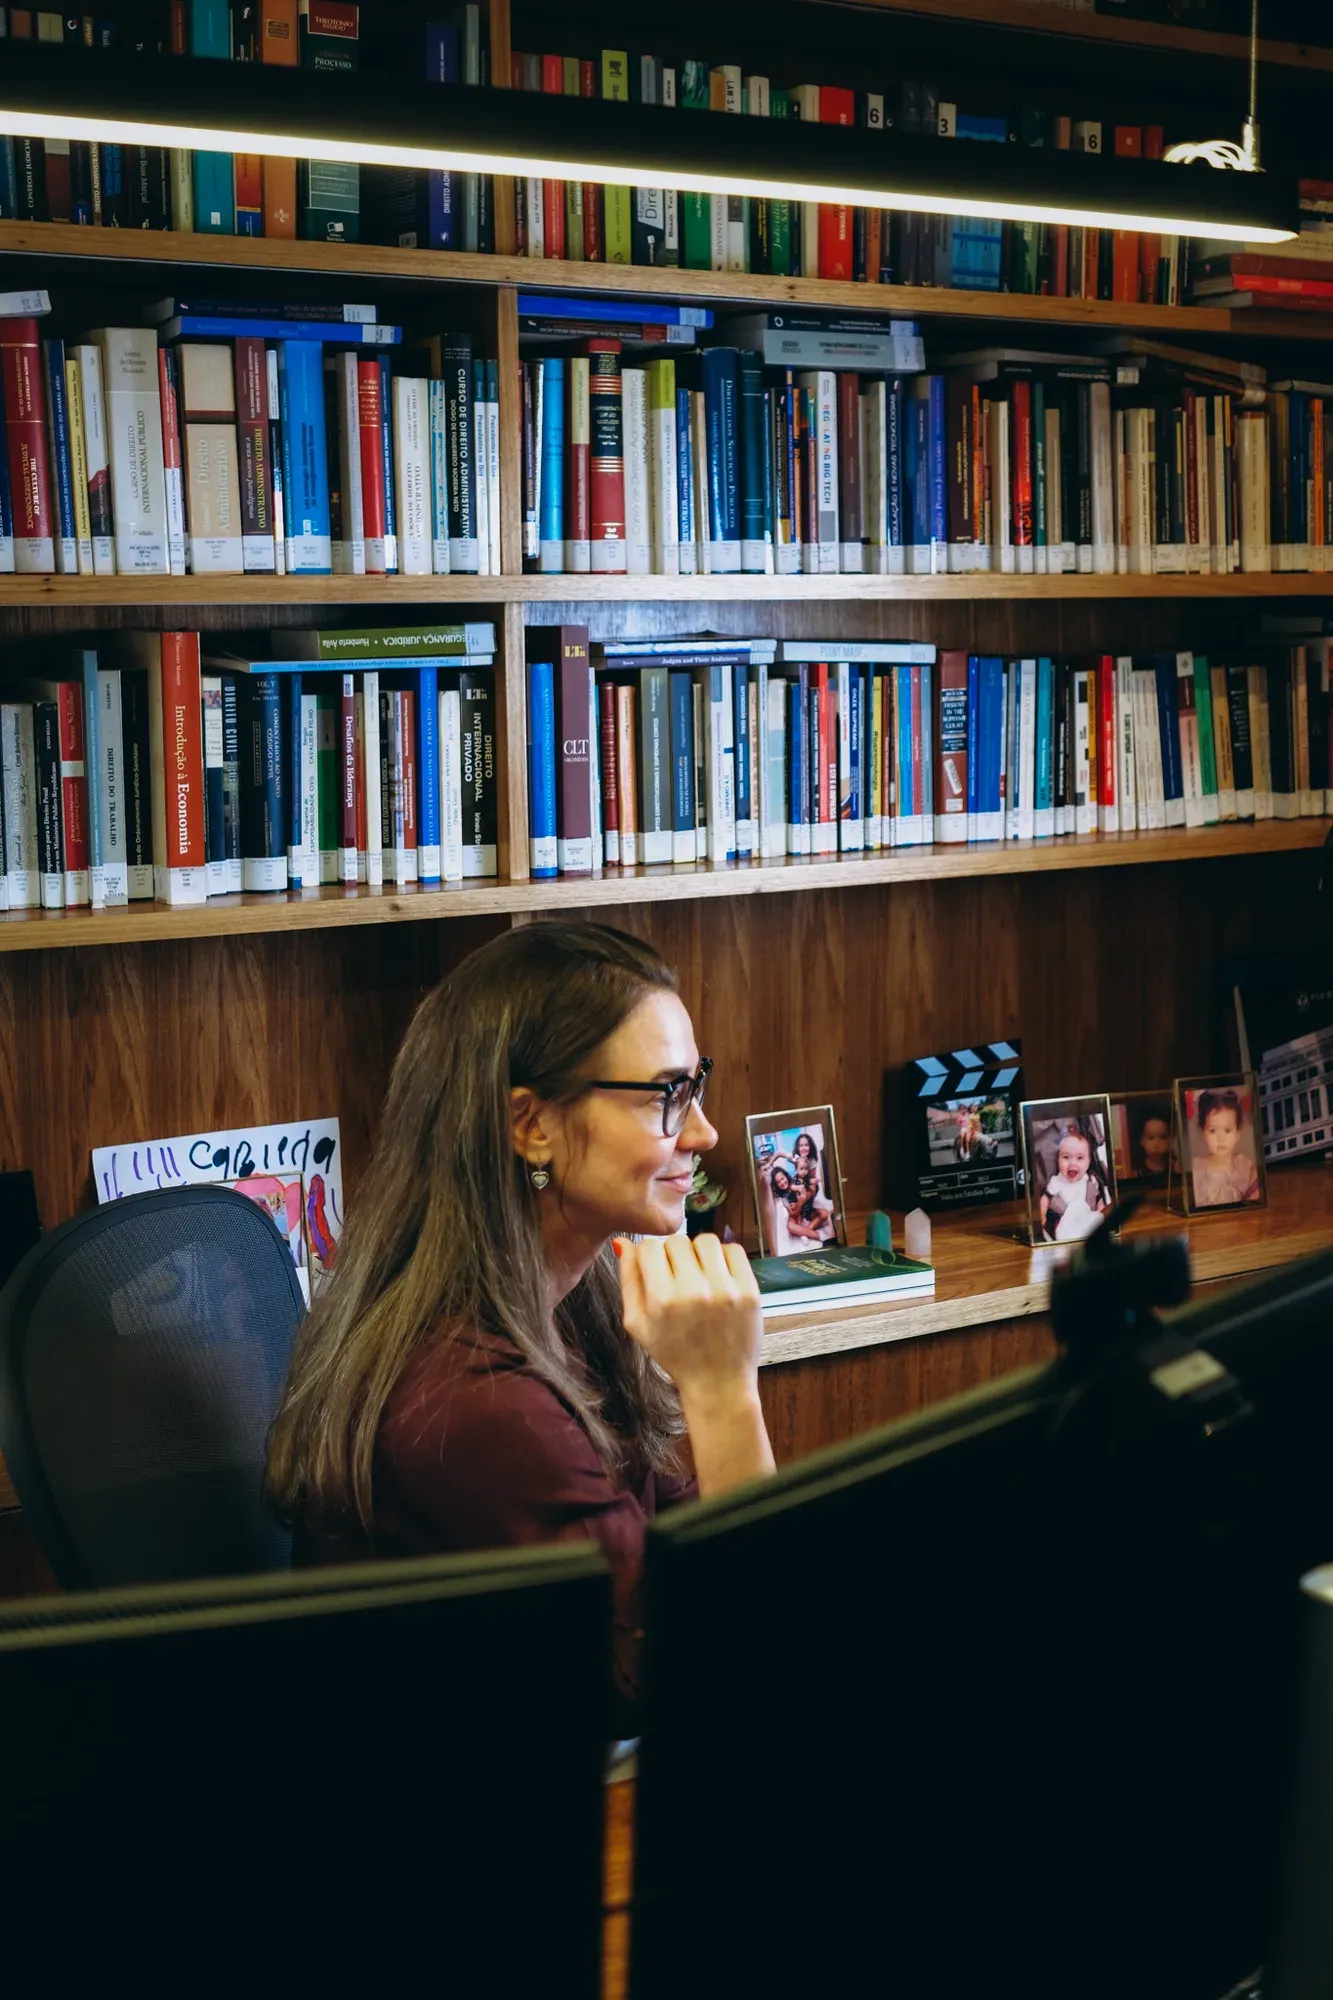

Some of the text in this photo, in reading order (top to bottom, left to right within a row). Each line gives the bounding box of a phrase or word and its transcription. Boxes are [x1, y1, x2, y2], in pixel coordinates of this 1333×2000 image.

[314, 16, 354, 28] THEOTONIO
[314, 57, 352, 69] PROCESSO
[869, 108, 880, 124] 6
[939, 118, 949, 134] 3
[1088, 134, 1098, 150] 6
[140, 178, 149, 203] Marçal
[442, 188, 451, 214] DIREITO
[645, 189, 658, 219] Dire
[627, 375, 638, 448] Administrativo
[725, 379, 733, 417] DIREITO
[451, 422, 457, 430] DE
[60, 445, 69, 486] CONTROVÉRSIAS
[127, 425, 138, 499] CURSO DE DIREITO
[136, 410, 151, 513] INTERNACIONAL PÚBLICO
[195, 439, 210, 484] Direito
[245, 442, 253, 457] seus
[457, 368, 470, 539] CURSO DE DIREITO ADMINISTRATIVO
[726, 439, 735, 482] SERVIÇOS
[20, 442, 34, 529] JUDICIAL INDEPENDENCE
[216, 439, 230, 532] Administrativo
[254, 428, 266, 528] DIREITO ADMINISTRATIVO
[823, 463, 831, 478] BIG
[890, 454, 898, 484] NOVAS
[31, 473, 39, 503] CULTURE
[245, 478, 255, 519] paradigmas
[407, 500, 413, 511] DE
[33, 504, 40, 515] OF
[891, 494, 899, 544] REGULAÇÃO
[322, 634, 466, 650] EGURANÇA JURÍDICA Humberto Ávila
[820, 644, 843, 657] POINT
[661, 657, 682, 665] Judges
[695, 656, 710, 664] Their
[66, 691, 77, 750] Simone Schreiber
[174, 705, 187, 770] Introdução
[224, 686, 237, 754] DIREITO CIVIL
[266, 728, 274, 759] CÓDIGO
[464, 732, 472, 782] PRIVADO
[473, 712, 482, 802] INTERNACIONAL
[484, 734, 492, 778] DIREITO
[563, 739, 590, 755] CLT
[50, 762, 58, 797] Republicano
[275, 763, 281, 774] AO
[345, 716, 355, 808] Desafios da liderança
[51, 798, 59, 821] Público
[107, 748, 117, 845] DIREITO DO TRABALHO
[132, 743, 142, 852] do Ordenamento Jurídico-Sanitário
[653, 771, 661, 815] CONSTITUCIONAIS
[51, 822, 59, 850] Ministério
[177, 783, 190, 855] Economia
[54, 850, 60, 859] um
